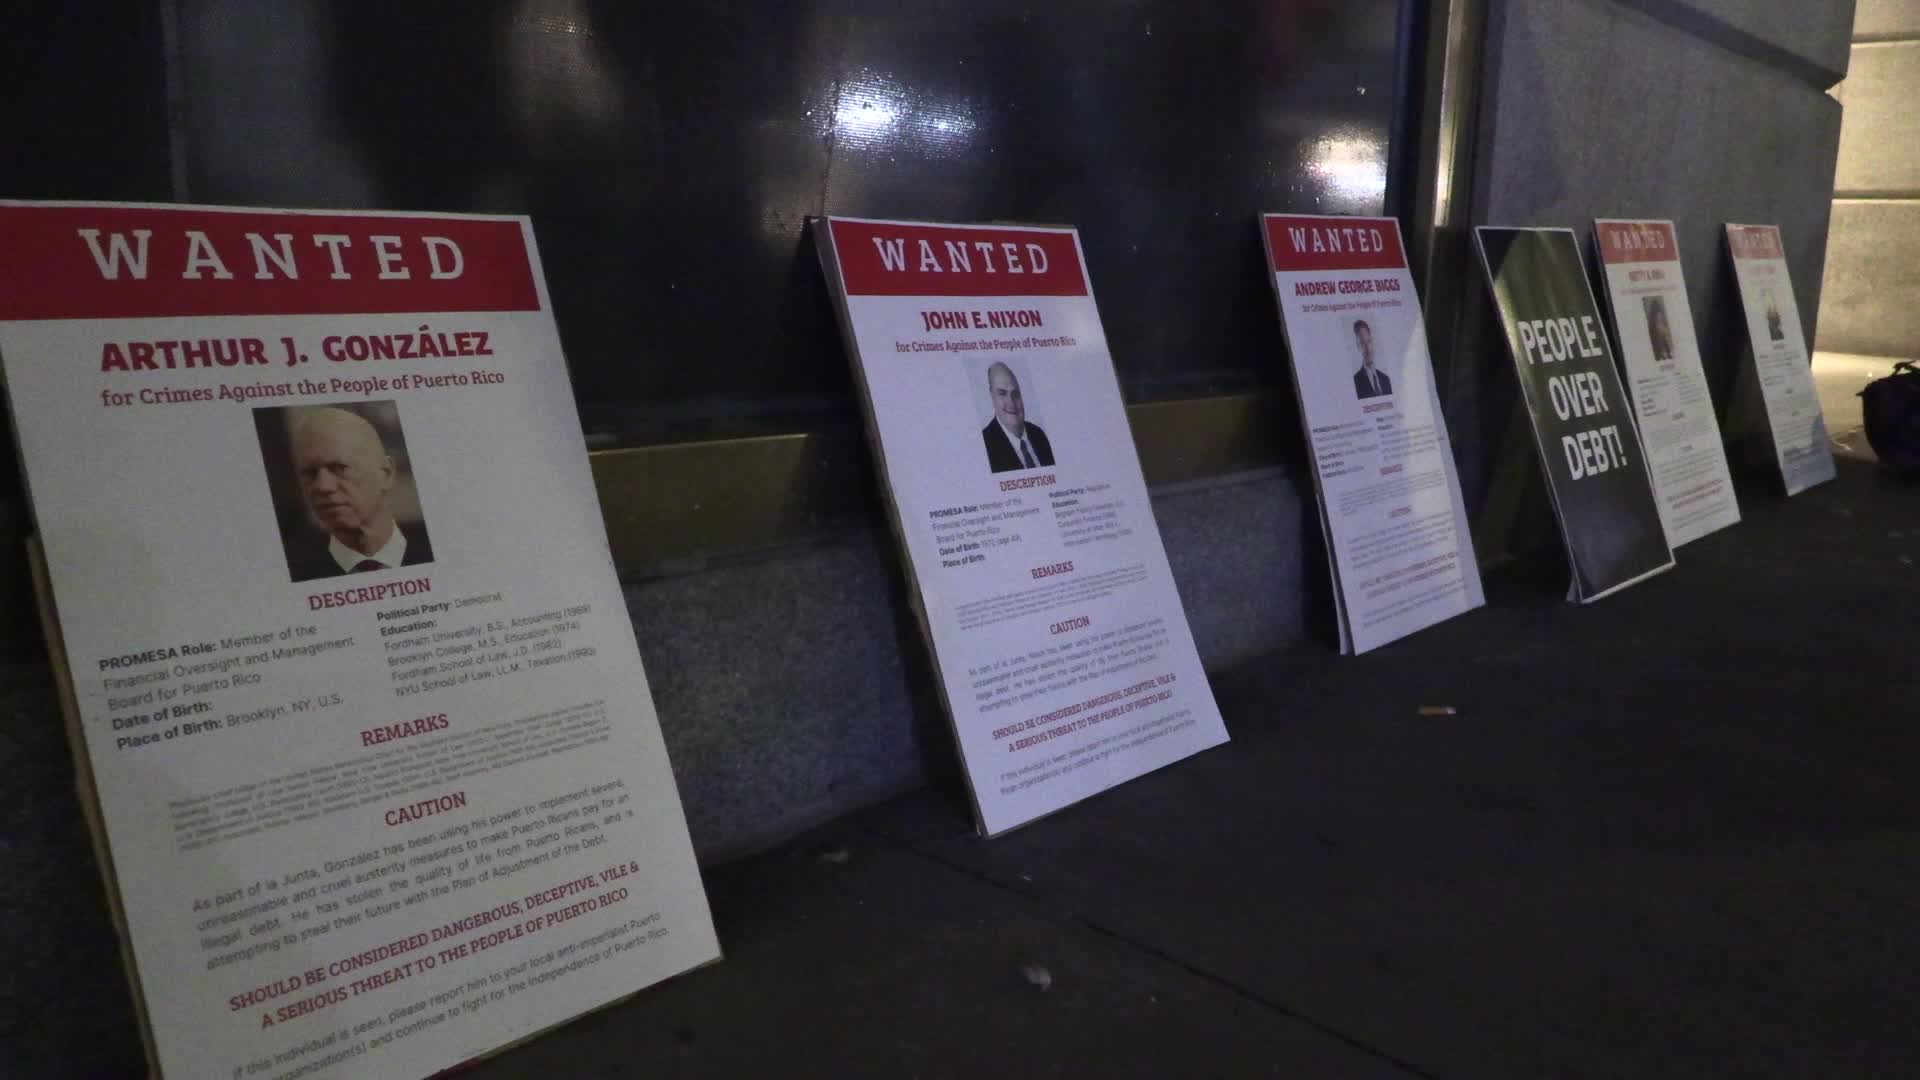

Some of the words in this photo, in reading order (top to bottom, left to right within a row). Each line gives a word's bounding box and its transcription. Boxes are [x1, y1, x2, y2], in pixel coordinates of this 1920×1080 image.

[79, 228, 466, 282] WANTED
[872, 237, 1049, 274] WANTED
[1288, 227, 1384, 253] WANTED
[1295, 281, 1336, 296] ANDREW
[1338, 279, 1374, 294] GEORGE
[1375, 278, 1400, 292] BIGGS
[921, 311, 968, 332] JOHN
[972, 311, 987, 329] E.
[989, 310, 1042, 329] NIXON
[98, 339, 268, 370] ARTHUR
[281, 338, 309, 365] J.
[319, 324, 494, 360] GONZÁLEZ
[896, 341, 909, 352] for
[912, 341, 944, 352] Crimes
[945, 340, 977, 353] Against
[979, 339, 993, 350] the
[994, 339, 1021, 351] People
[1022, 338, 1031, 348] of
[1032, 336, 1059, 348] Puerto
[1518, 315, 1603, 365] PEOPLE
[100, 389, 135, 407] for
[138, 386, 214, 404] Crimes
[217, 381, 294, 401] Against
[298, 380, 327, 396] the
[330, 377, 387, 394] People
[392, 374, 411, 392] of
[412, 373, 469, 389] Puerto
[471, 371, 505, 385] Rico
[1548, 371, 1609, 421] OVER
[1562, 425, 1627, 481] DEBT!
[999, 474, 1056, 491] DESCRIPTION
[1031, 560, 1074, 579] REMARKS
[308, 579, 431, 609] DESCRIPTION
[377, 607, 419, 621] Political
[381, 620, 435, 635] Education:
[1049, 615, 1089, 634] CAUTION
[99, 649, 177, 669] PROMESA
[181, 642, 217, 656] Role:
[220, 632, 275, 649] Member
[278, 626, 292, 641] of
[295, 624, 318, 638] the
[104, 669, 169, 691] Financial
[174, 658, 240, 678] Oversight
[244, 651, 268, 666] and
[272, 638, 355, 660] Management
[108, 692, 152, 710] Board
[157, 686, 178, 700] for
[182, 679, 228, 694] Puerto
[232, 673, 261, 686] Rico
[112, 714, 148, 729] Date
[153, 707, 169, 722] of
[173, 702, 212, 717] Birth:
[117, 733, 159, 749] Place
[162, 725, 179, 740] of
[183, 719, 221, 735] Birth:
[361, 715, 448, 745] REMARKS
[992, 722, 1024, 740] SHOULD
[1024, 718, 1035, 728] BE
[1035, 703, 1082, 725] CONSIDERED
[1008, 743, 1015, 752] A
[1015, 731, 1047, 750] SERIOUS
[1047, 721, 1076, 739] THREAT
[1076, 718, 1086, 728] TO
[1086, 713, 1099, 725] THE
[1100, 705, 1125, 720] PEOPLE
[1125, 702, 1133, 712] OF
[386, 793, 466, 826] CAUTION
[191, 896, 211, 913] As
[215, 888, 243, 906] part
[246, 881, 262, 897] of
[265, 877, 277, 892] la
[281, 867, 320, 886] Junta,
[382, 841, 405, 858] has
[408, 835, 437, 850] been
[471, 817, 487, 831] his
[490, 809, 522, 826] power
[523, 803, 537, 817] to
[282, 932, 297, 946] to
[334, 913, 362, 929] their
[365, 901, 401, 919] future
[403, 890, 429, 908] with
[429, 885, 450, 900] the
[478, 869, 489, 883] of
[551, 846, 563, 860] of
[563, 841, 581, 856] the
[229, 976, 302, 1010] SHOULD
[303, 965, 326, 987] BE
[329, 934, 429, 977] CONSIDERED
[432, 901, 522, 940] DANGEROUS,
[525, 876, 598, 908] DECEPTIVE,
[599, 864, 628, 884] VILE
[629, 860, 639, 875] &
[260, 1010, 274, 1028] A
[278, 987, 347, 1021] SERIOUS
[351, 965, 412, 995] THREAT
[414, 955, 437, 974] TO
[439, 945, 468, 964] THE
[470, 925, 523, 952] PEOPLE
[525, 916, 543, 934] OF
[547, 901, 597, 925] PUERTO
[599, 889, 628, 907] RICO
[389, 1000, 425, 1023] please
[430, 986, 465, 1007] report
[466, 974, 488, 993] him
[488, 970, 501, 984] to
[503, 959, 528, 980] your
[529, 949, 555, 970] local
[630, 913, 661, 931] Puerto
[368, 1030, 392, 1050] and
[396, 1013, 446, 1038] continue
[447, 1005, 459, 1019] to
[461, 992, 487, 1012] fight
[488, 986, 505, 1002] for
[508, 979, 526, 995] the
[602, 946, 613, 960] of
[615, 936, 646, 953] Puerto
